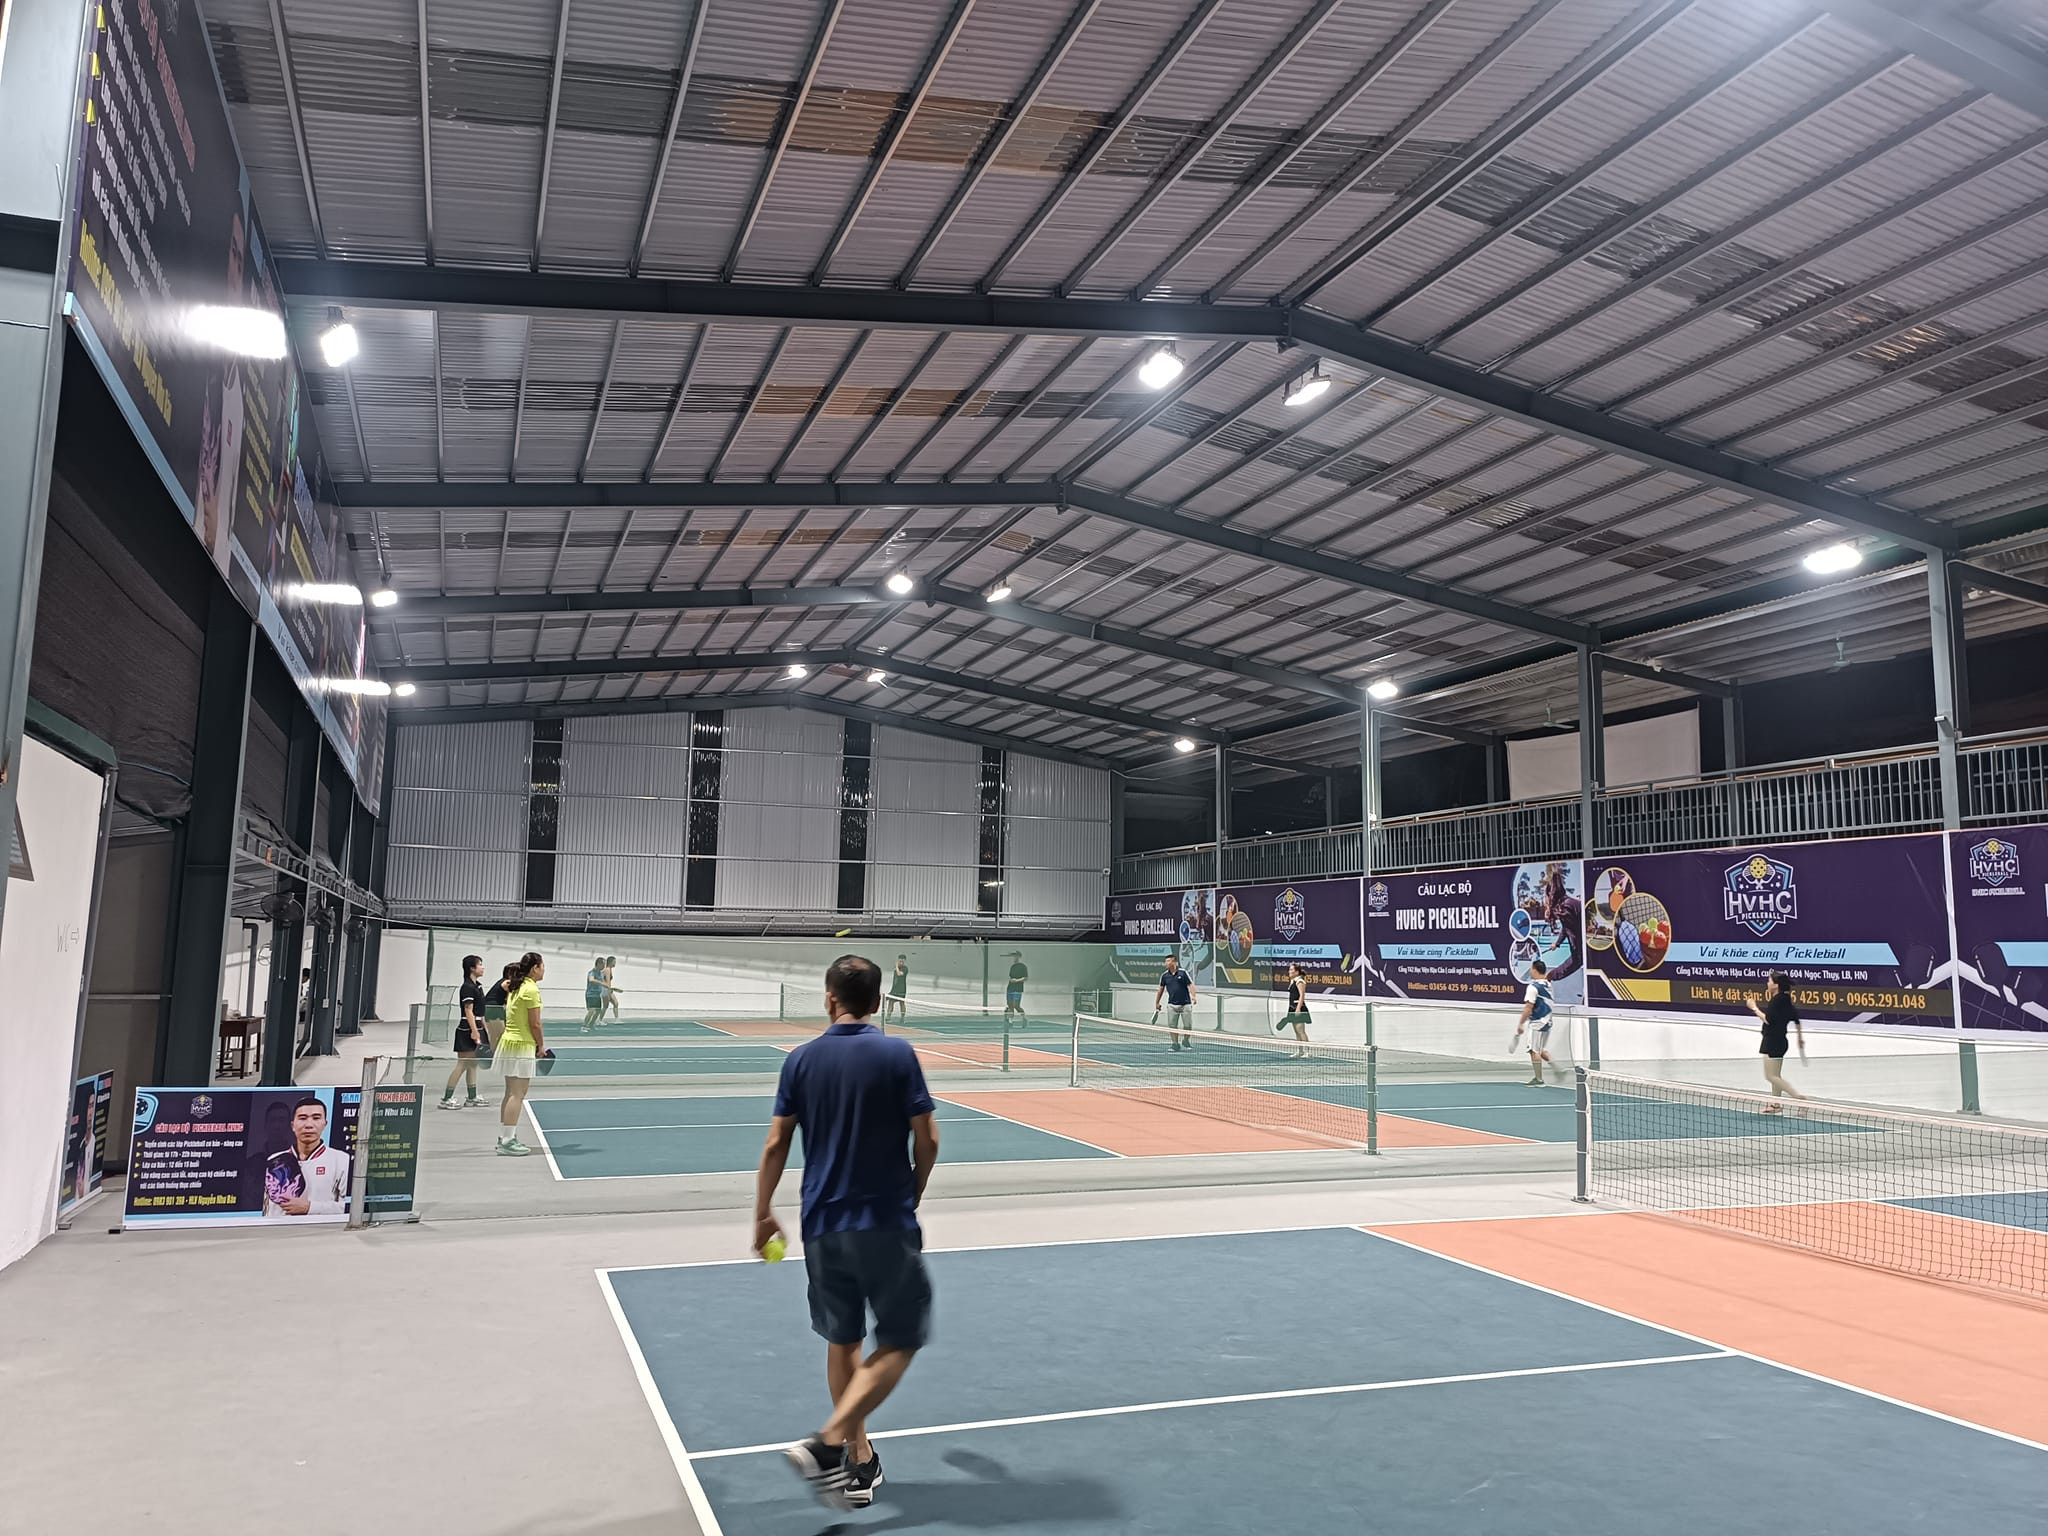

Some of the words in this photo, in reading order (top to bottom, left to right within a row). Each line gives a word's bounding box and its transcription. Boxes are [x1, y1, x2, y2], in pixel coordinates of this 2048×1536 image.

[1973, 859, 2016, 875] HVHC
[1418, 883, 1436, 896] CÂU
[1438, 884, 1456, 897] LẠC
[1458, 880, 1472, 896] BỘ
[1728, 891, 1792, 916] HVHC
[1277, 912, 1303, 928] HVHC
[1396, 908, 1425, 930] HVHC
[1428, 906, 1499, 929] PICKLEBALL
[1742, 911, 1781, 920] PICKLEBALL
[1140, 918, 1175, 935] PICKLEBALL
[1445, 946, 1479, 956] Pickleball
[1700, 946, 1719, 958] Vui
[1753, 948, 1779, 961] cùng
[1785, 947, 1846, 960] Pickleball
[1691, 967, 1702, 976] T42
[1703, 968, 1715, 978] Học
[1715, 968, 1728, 978] Viện
[1729, 968, 1742, 978] Hậu
[1790, 969, 1802, 978] 604
[1804, 970, 1822, 980] Ngọc
[1854, 970, 1868, 981] HN)
[1691, 986, 1710, 999] Liên
[1712, 987, 1724, 1003] hệ
[1725, 988, 1740, 1003] đặt
[1800, 990, 1820, 1004] 425
[1823, 991, 1837, 1005] 99
[1846, 992, 1926, 1009] 0965.291.048
